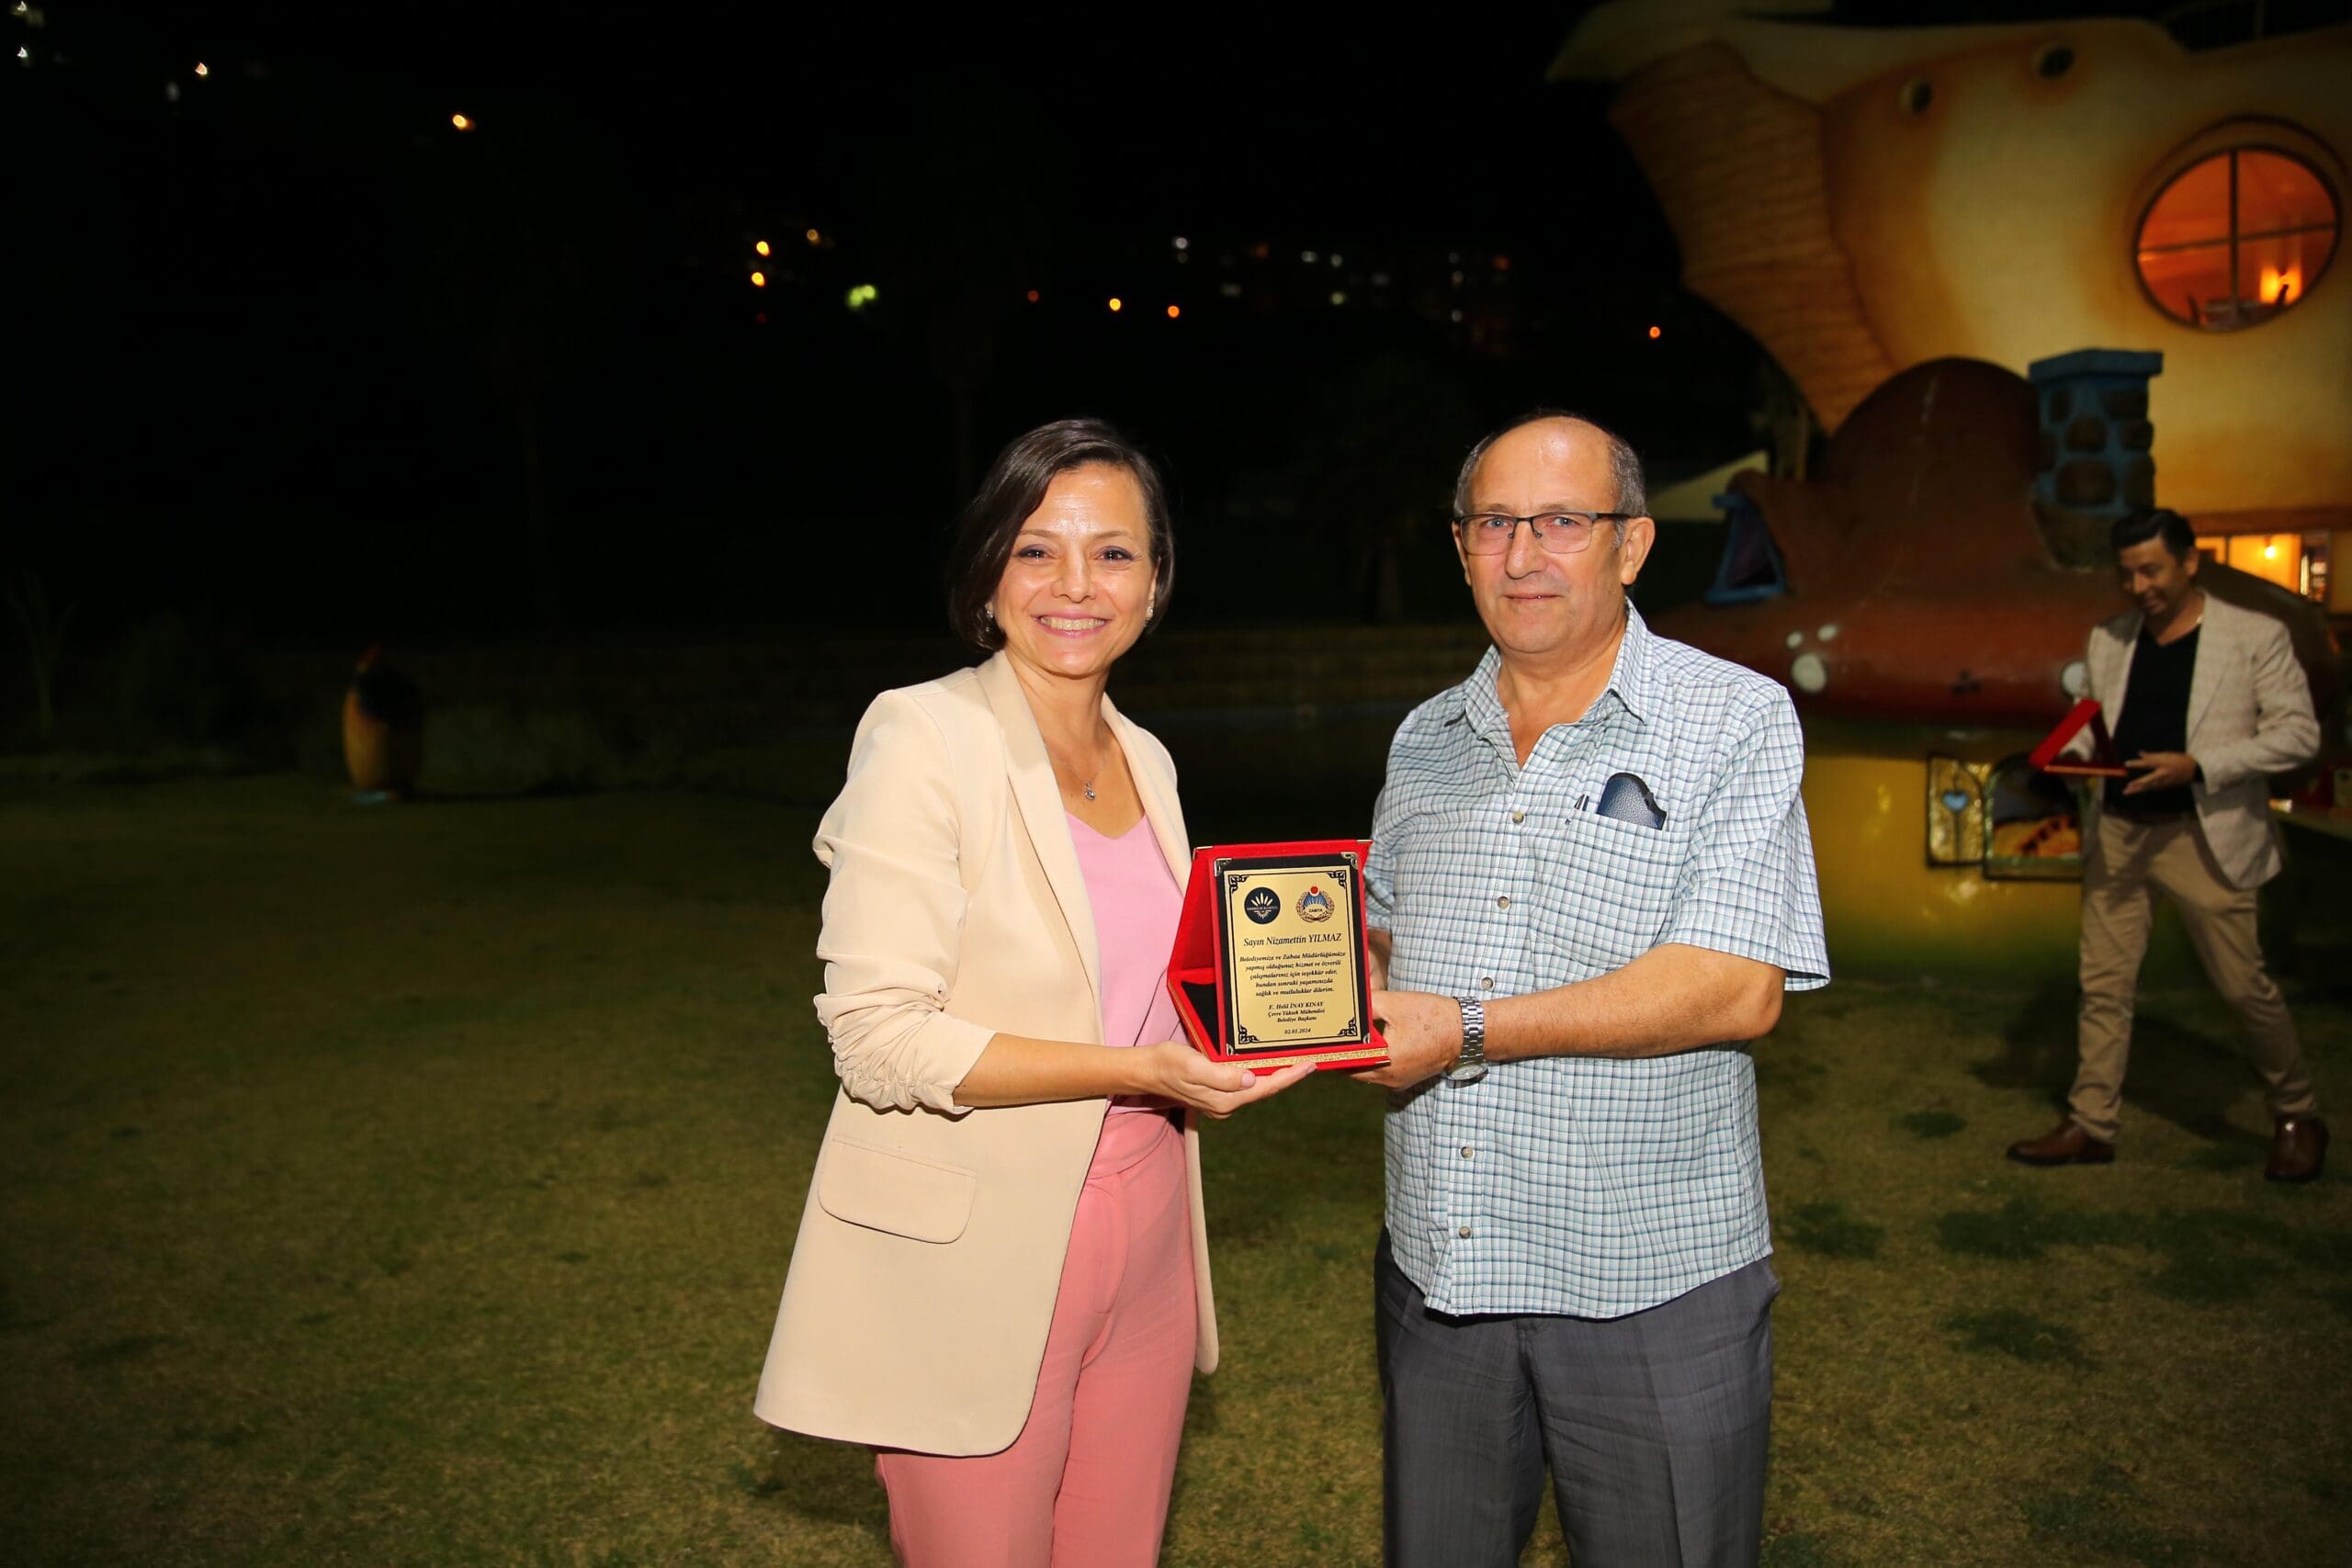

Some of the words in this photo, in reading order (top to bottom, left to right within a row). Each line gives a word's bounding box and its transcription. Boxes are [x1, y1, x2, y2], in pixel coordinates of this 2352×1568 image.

[1244, 937, 1264, 947] Sayın
[1266, 934, 1306, 945] Nizamettin
[1308, 933, 1342, 943] YILMAZ
